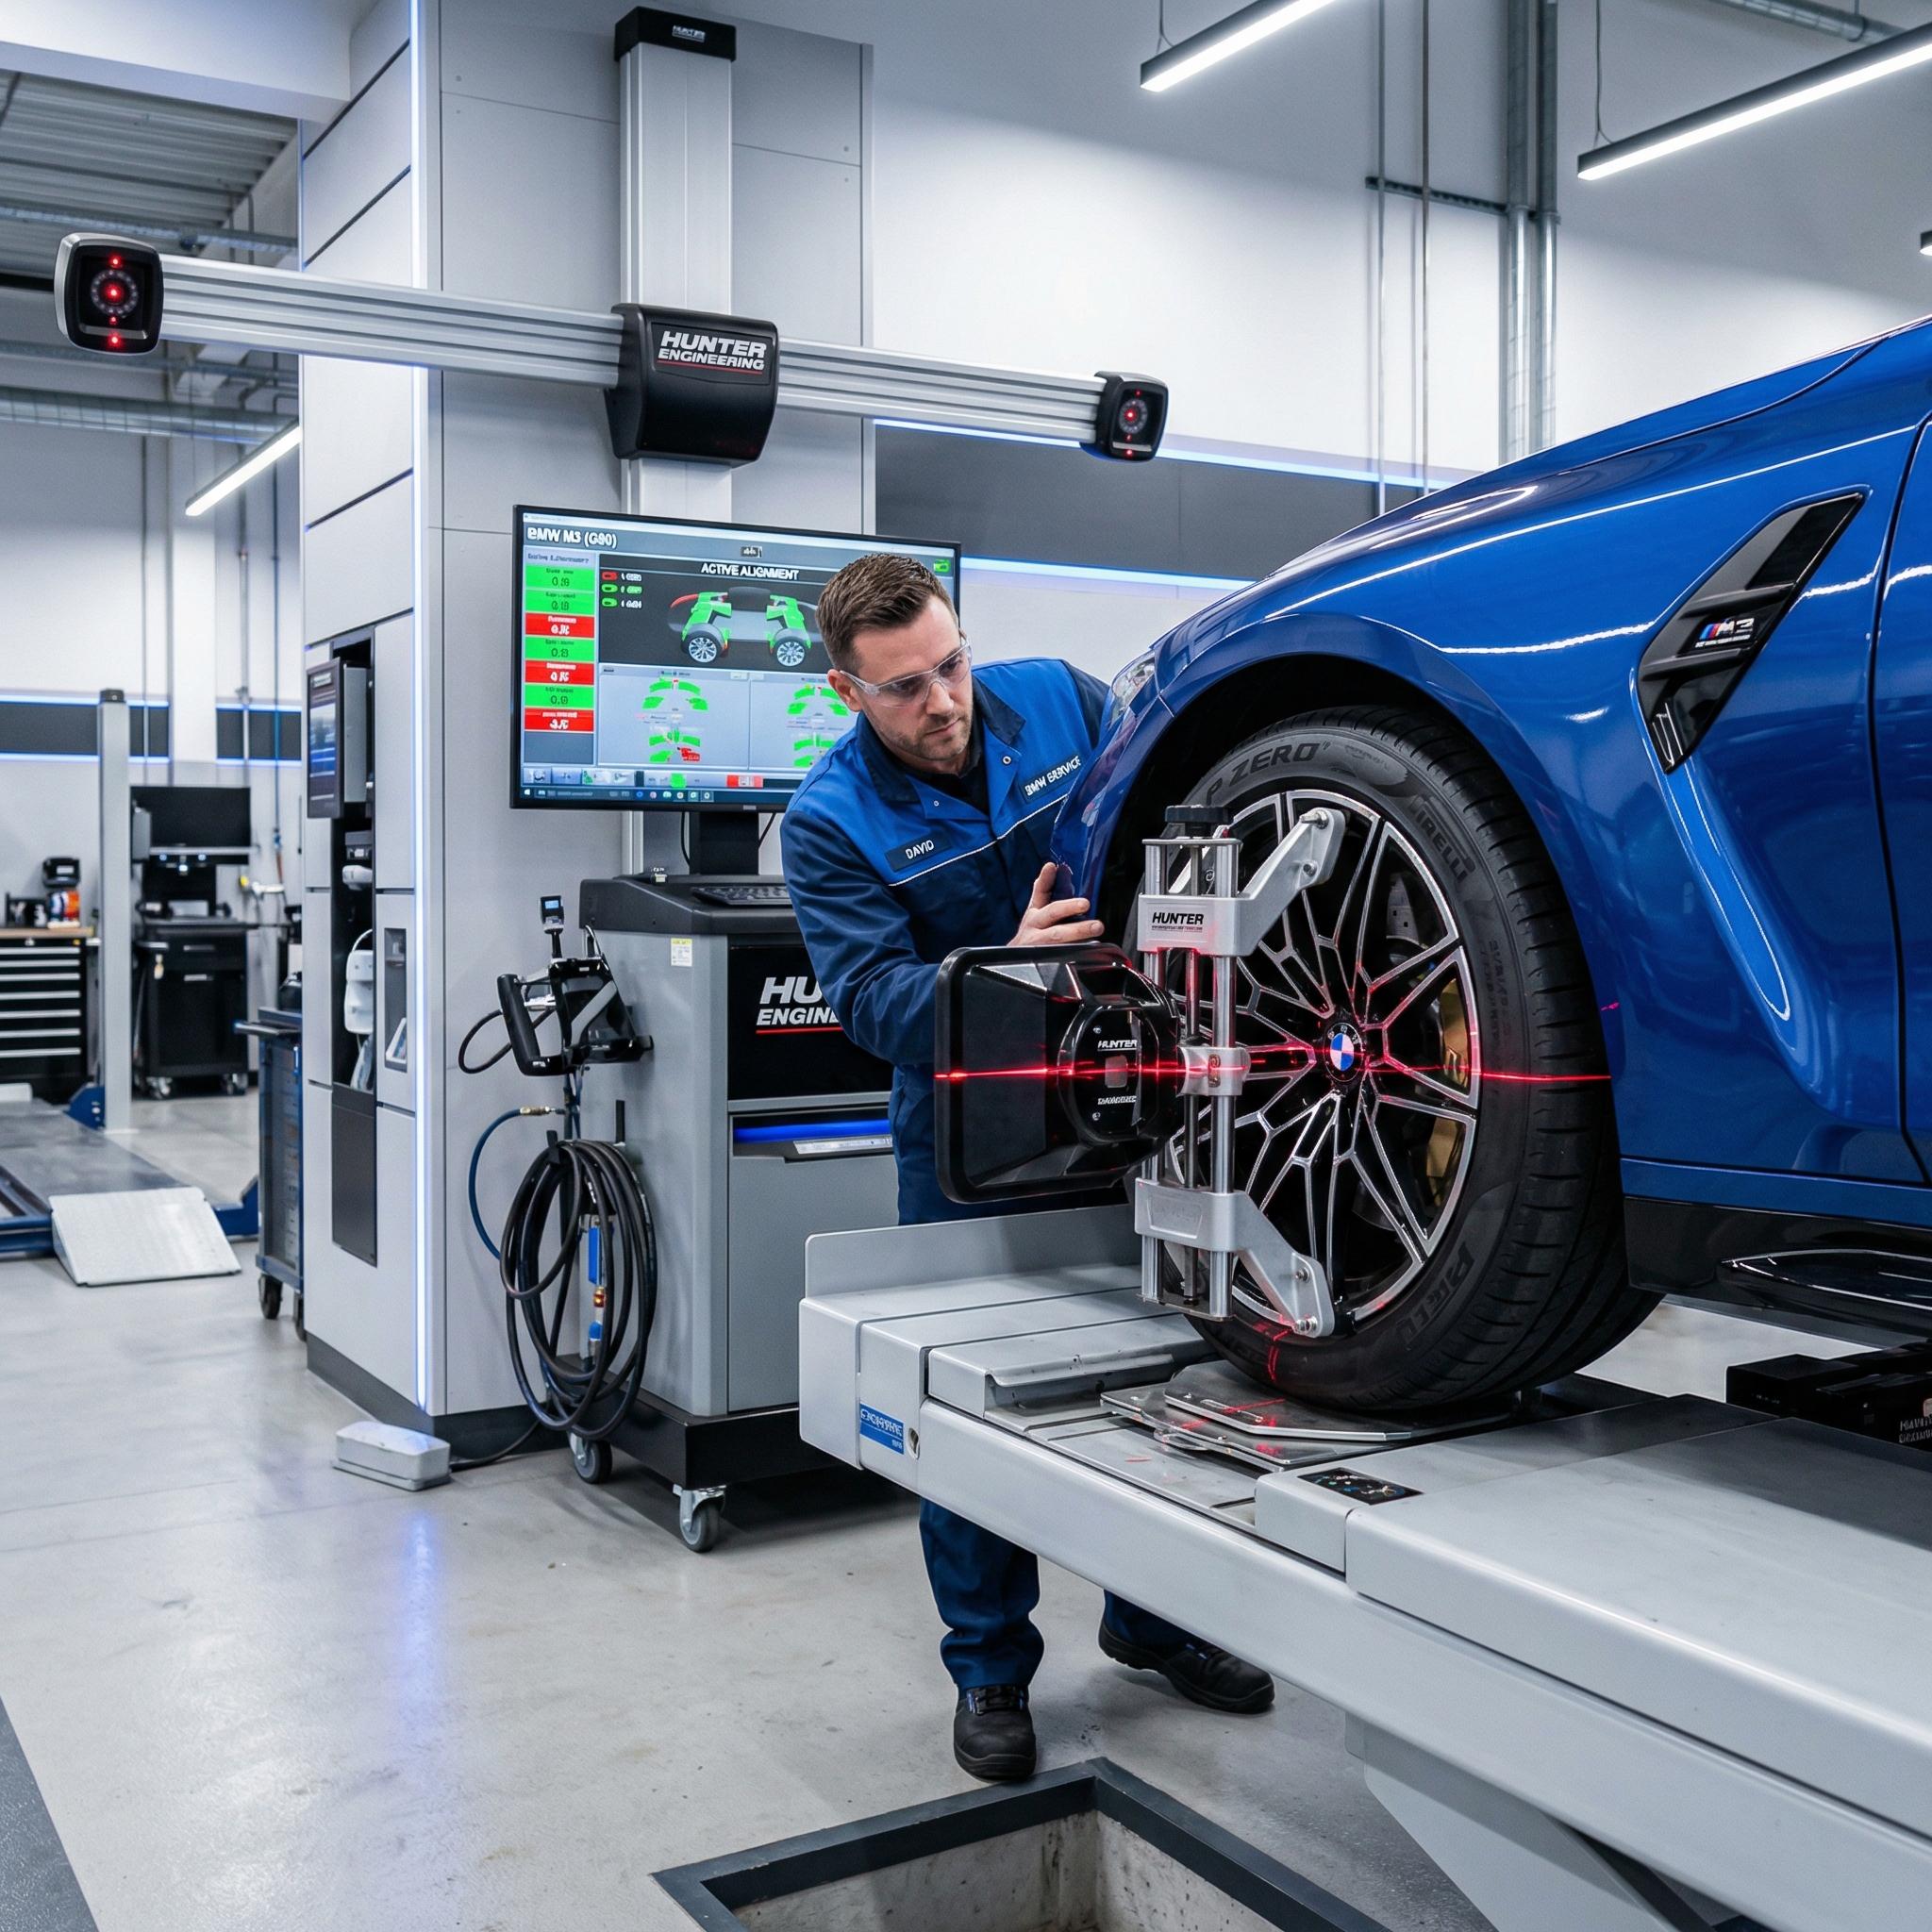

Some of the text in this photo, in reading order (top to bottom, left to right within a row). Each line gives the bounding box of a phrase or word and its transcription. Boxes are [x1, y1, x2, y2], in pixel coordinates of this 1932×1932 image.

[660, 330, 767, 358] HUNTER
[658, 347, 765, 371] ENGINEERING
[701, 562, 740, 576] ACTIVE
[1206, 777, 1224, 806] P
[1228, 742, 1321, 788] ZERO
[905, 840, 935, 859] DAVID
[1152, 911, 1205, 925] HUNTER
[758, 975, 823, 1005] HU
[1097, 1040, 1138, 1049] HUNTER
